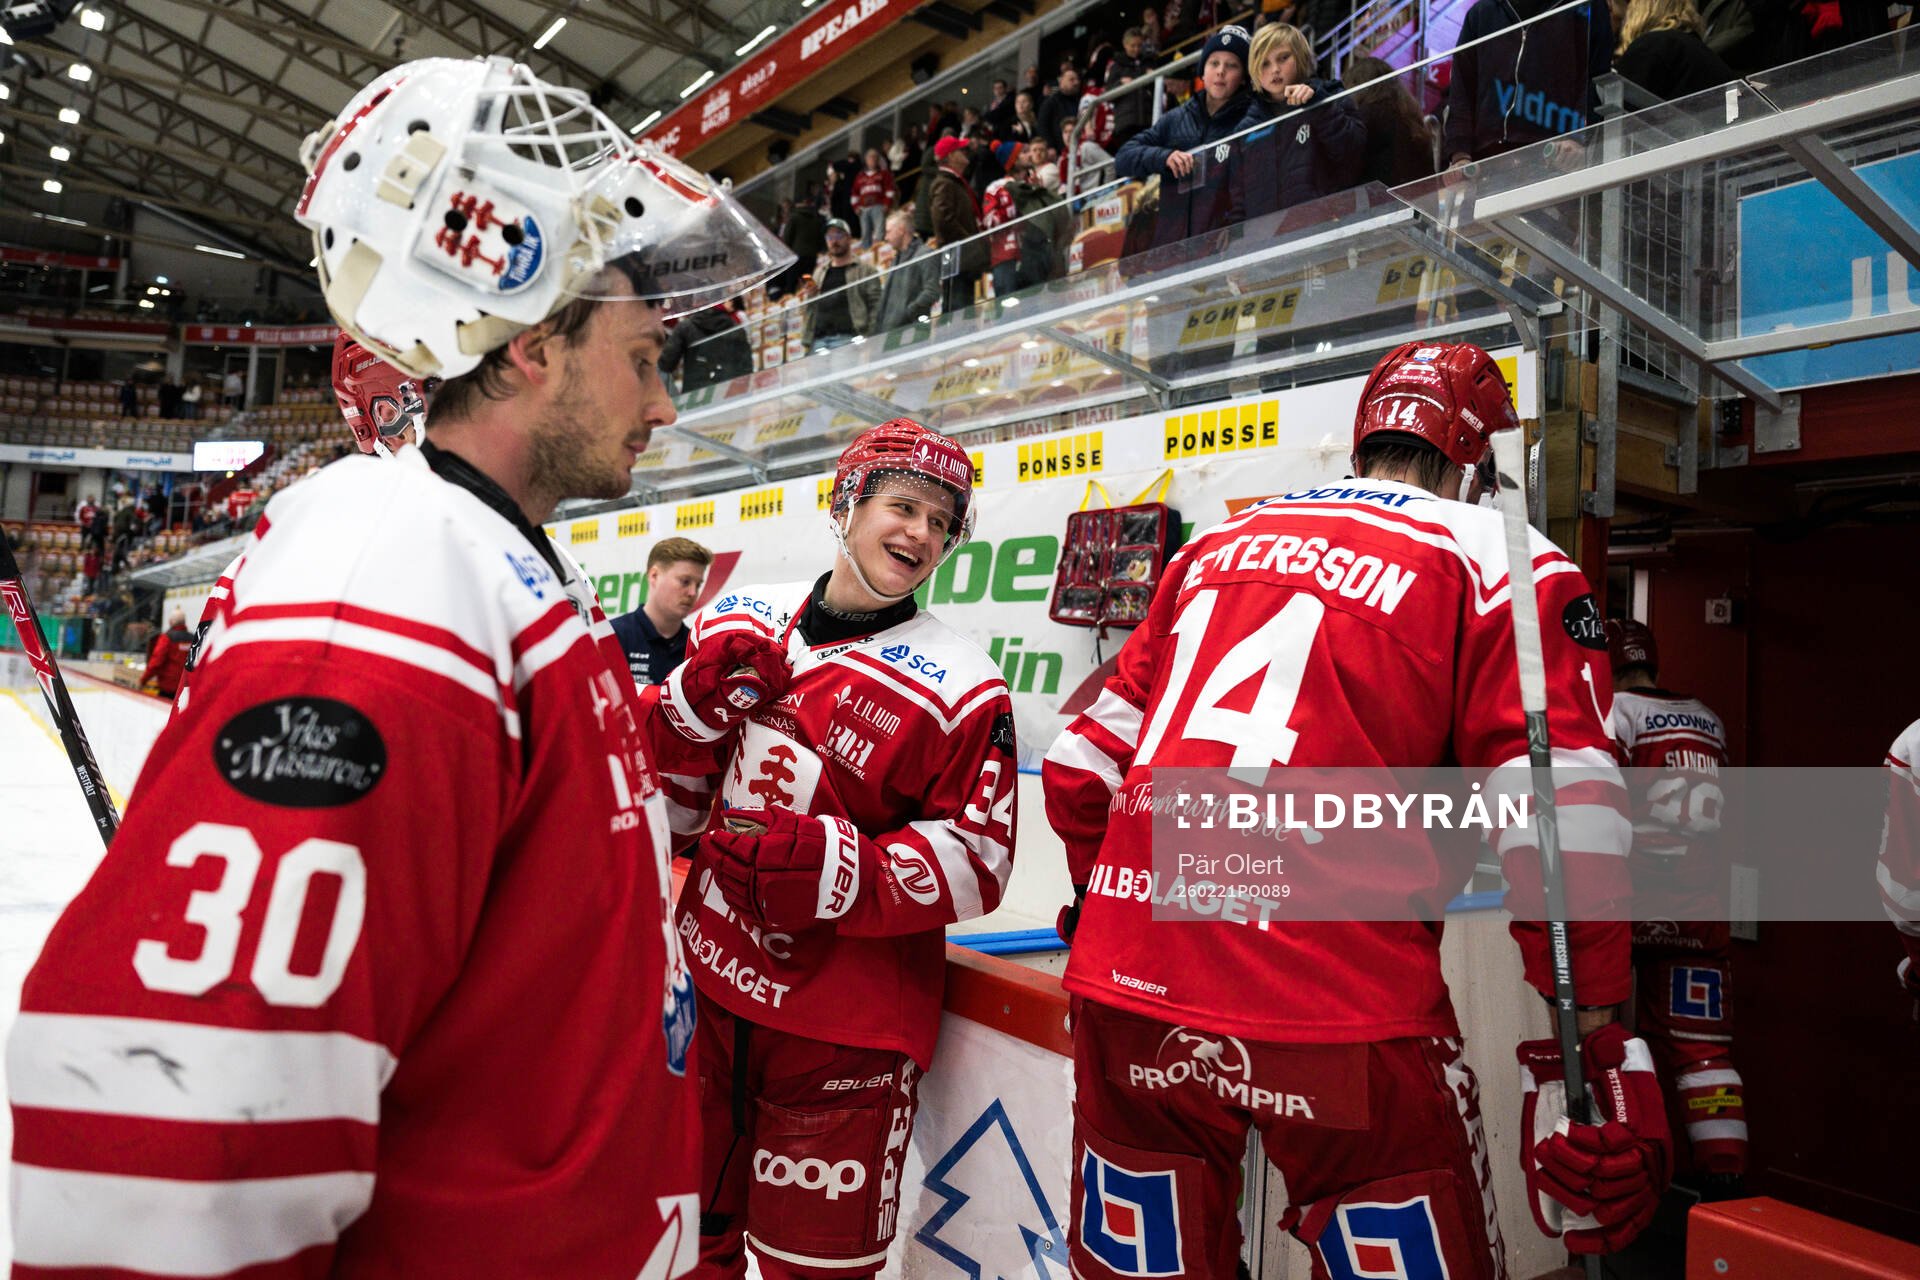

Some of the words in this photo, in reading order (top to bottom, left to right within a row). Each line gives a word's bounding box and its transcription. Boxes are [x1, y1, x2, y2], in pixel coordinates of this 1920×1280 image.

[641, 252, 728, 276] AUER
[1385, 400, 1419, 426] 14
[1166, 421, 1276, 454] PONSSE
[1019, 450, 1101, 477] PONSSE
[676, 511, 714, 527] PONSSE
[740, 499, 783, 517] PONSSE
[906, 654, 947, 684] SCA
[1130, 588, 1326, 786] 14
[1580, 661, 1617, 740] 1
[853, 695, 901, 736] LILIUM
[1645, 714, 1718, 734] GOODWAY
[1665, 750, 1719, 778] SUNDIN
[964, 759, 1015, 839] 34
[132, 821, 367, 1008] 30
[1631, 934, 1704, 950] ROLYMPIA
[1120, 975, 1168, 996] BAUER
[822, 1072, 893, 1091] BAUER
[1129, 1059, 1315, 1119] PROLYMPIA
[1609, 1067, 1626, 1124] PETTERSSON
[880, 1057, 918, 1208] PEA
[753, 1148, 867, 1201] coop
